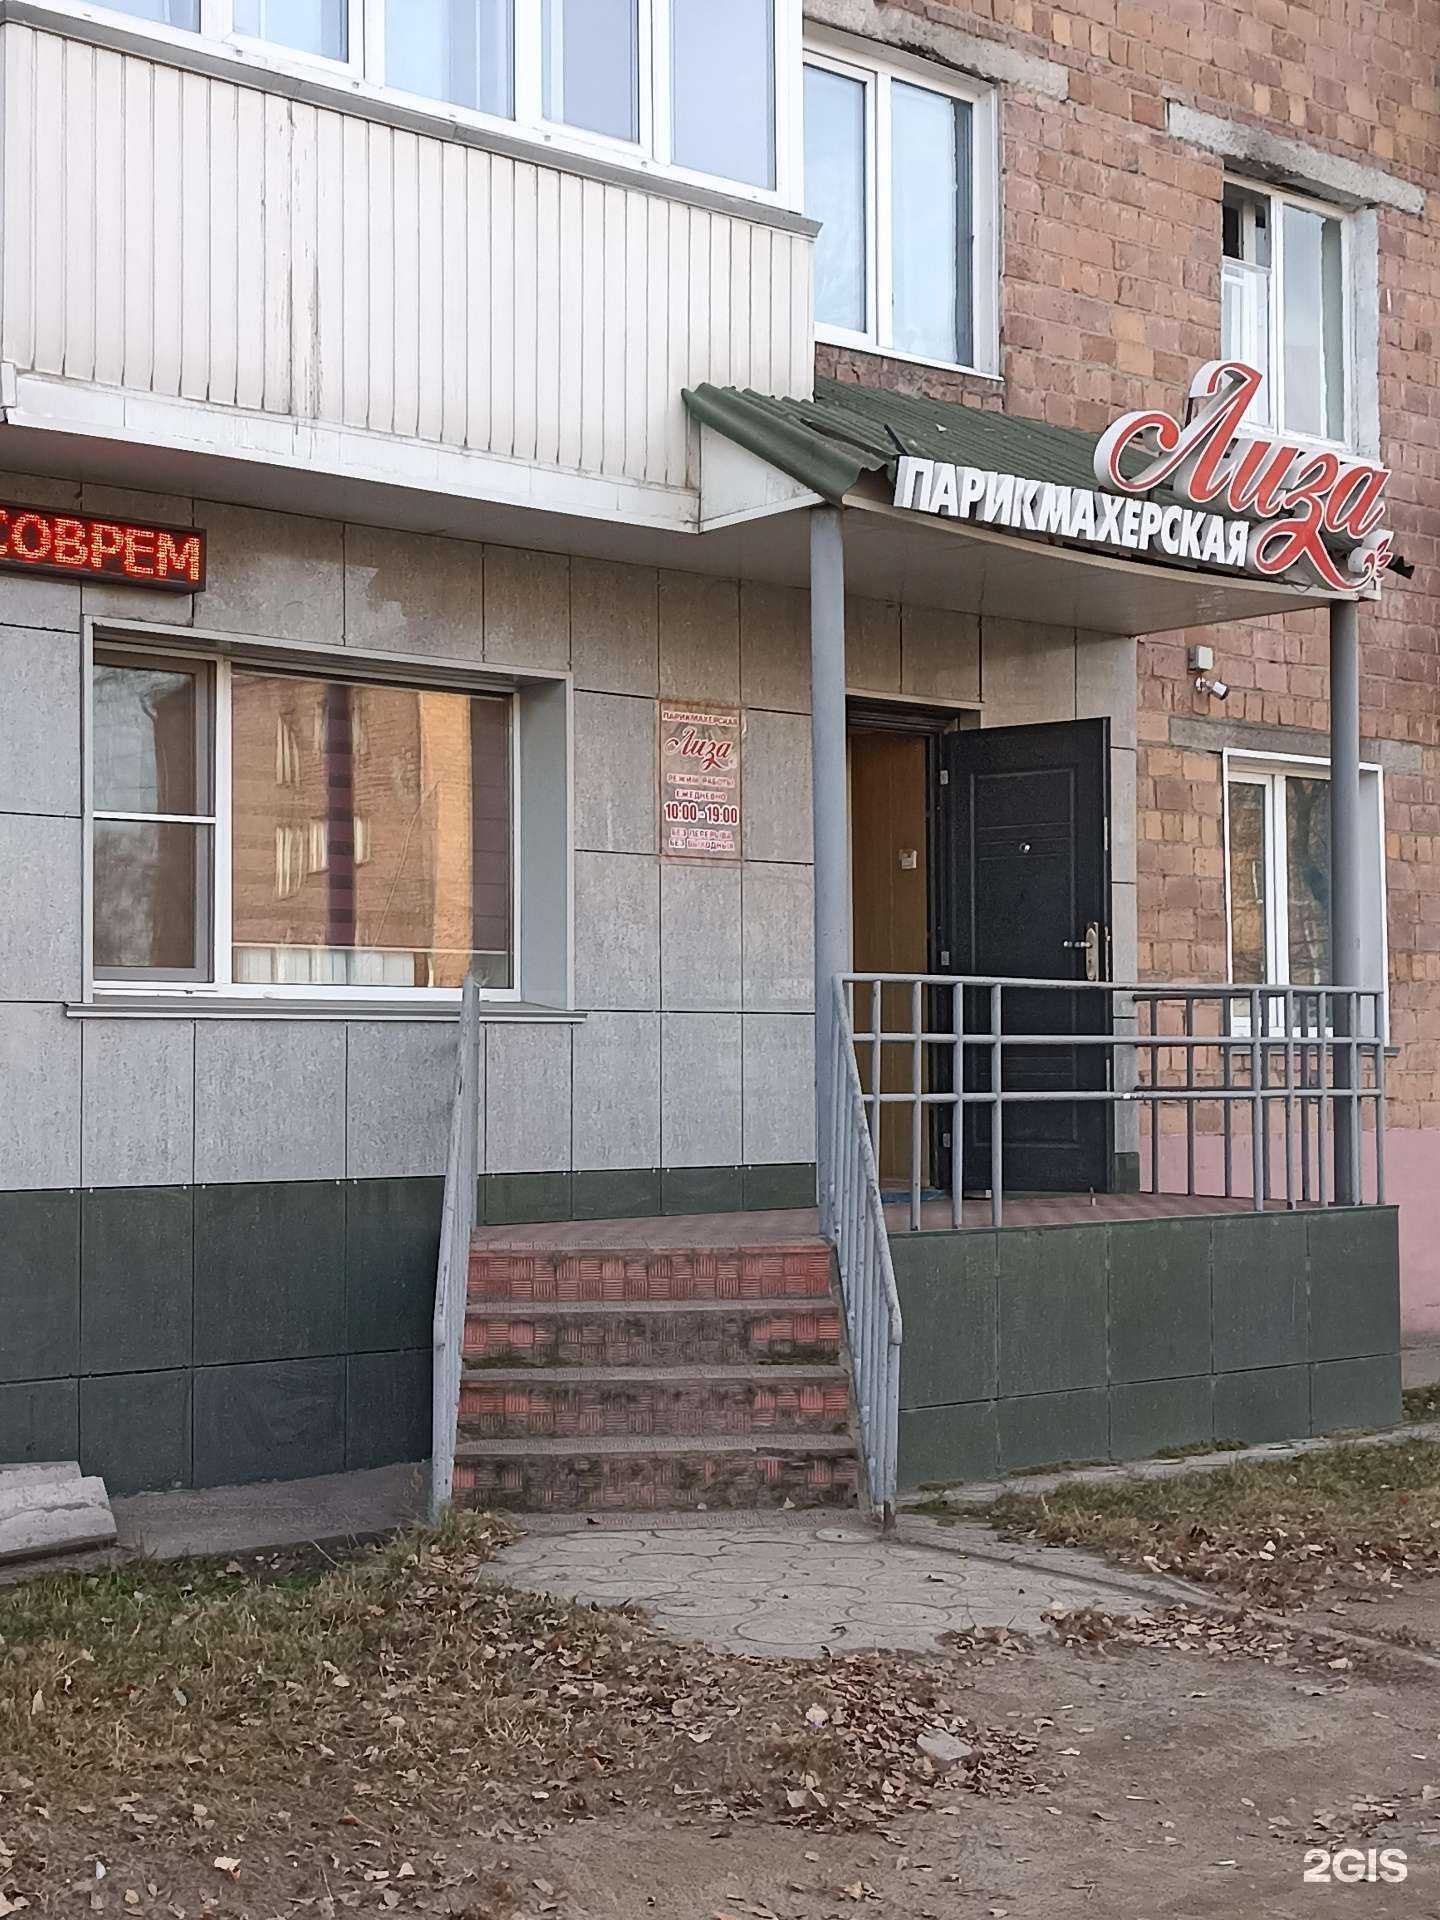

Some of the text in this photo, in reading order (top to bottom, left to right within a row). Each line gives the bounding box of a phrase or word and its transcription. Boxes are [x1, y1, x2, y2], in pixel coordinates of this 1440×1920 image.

[894, 456, 1249, 567] ПАРИКМАХЕРСКАЯ
[1095, 360, 1391, 592] Лиза
[0, 508, 200, 581] ОВРЕМ
[665, 727, 732, 772] Лиза
[676, 790, 726, 801] ЕЖЕДНЕВНО
